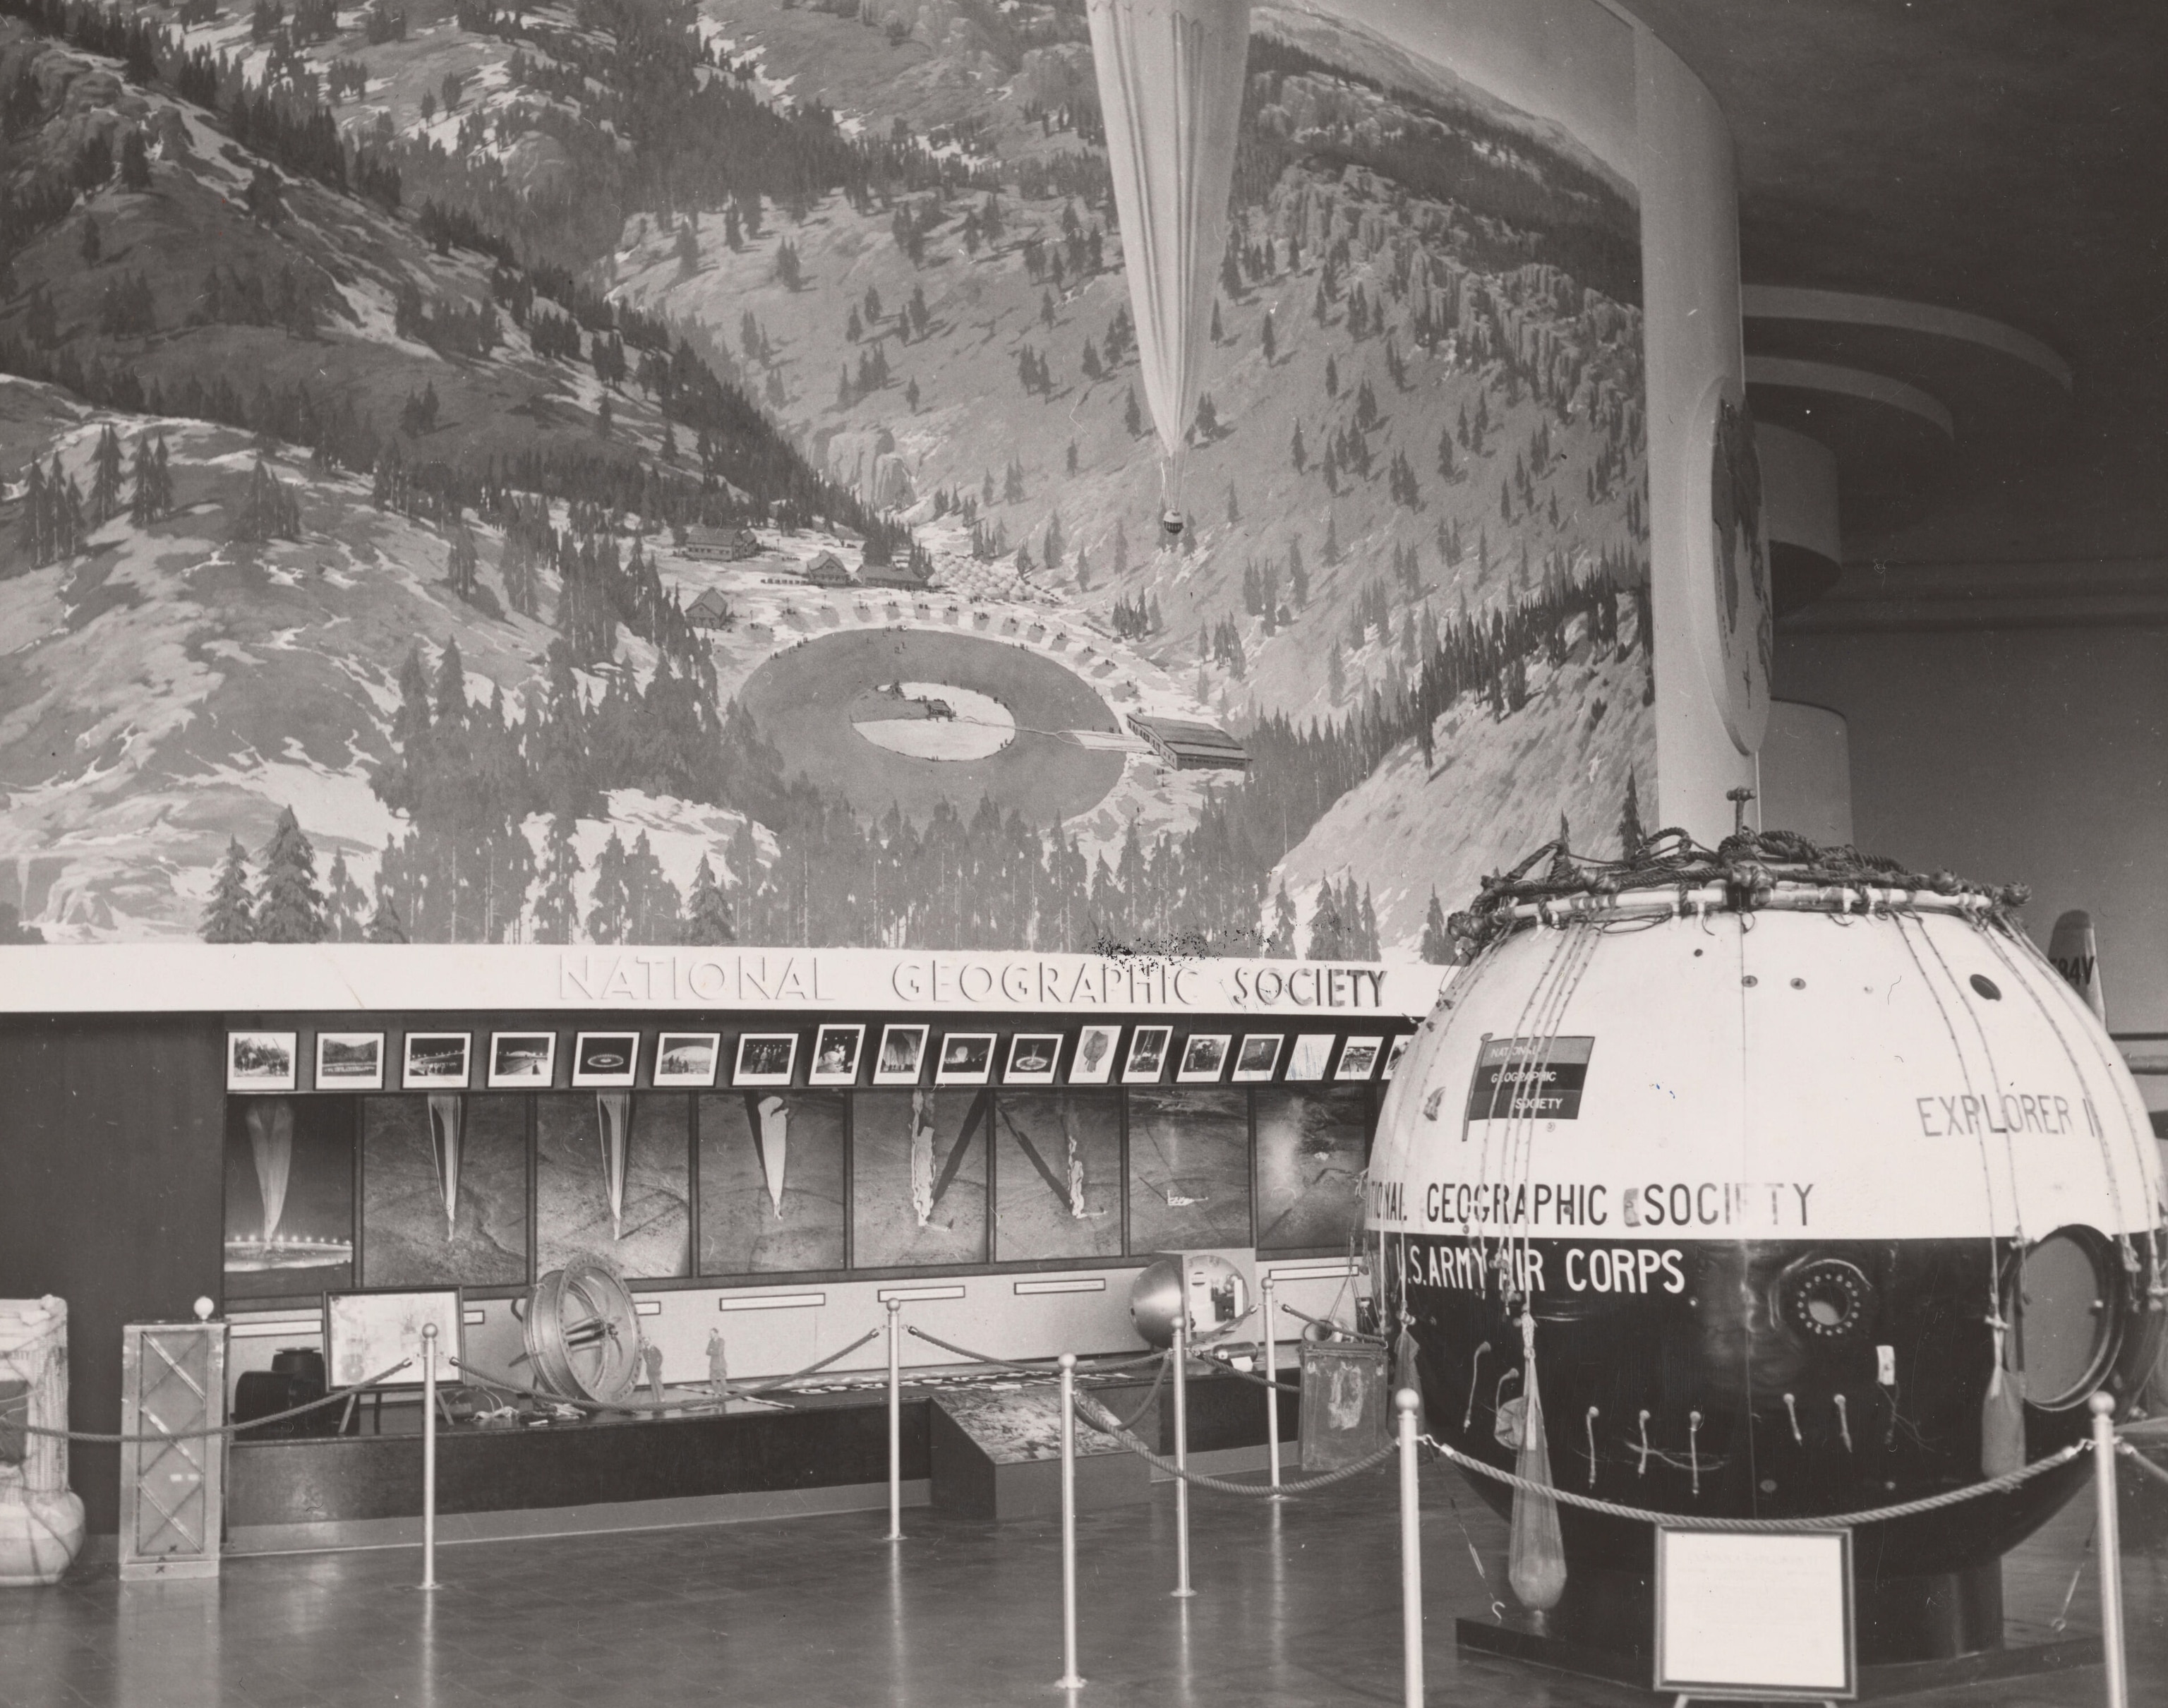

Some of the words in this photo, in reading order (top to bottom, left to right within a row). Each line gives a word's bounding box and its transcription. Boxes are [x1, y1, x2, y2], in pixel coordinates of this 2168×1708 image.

[560, 954, 836, 1001] NATIONAL
[892, 960, 1200, 1005] GEOGRAPHIC
[1233, 967, 1388, 1008] SOCIETY
[1491, 1045, 1537, 1057] NATONAL
[1490, 1071, 1557, 1083] GOGRAPHIC
[1515, 1098, 1563, 1109] SOCETY
[1916, 1094, 2073, 1137] EXPLORER
[1426, 1183, 1608, 1226] GEOGRAPHIC
[1565, 1248, 1685, 1294] CORPS
